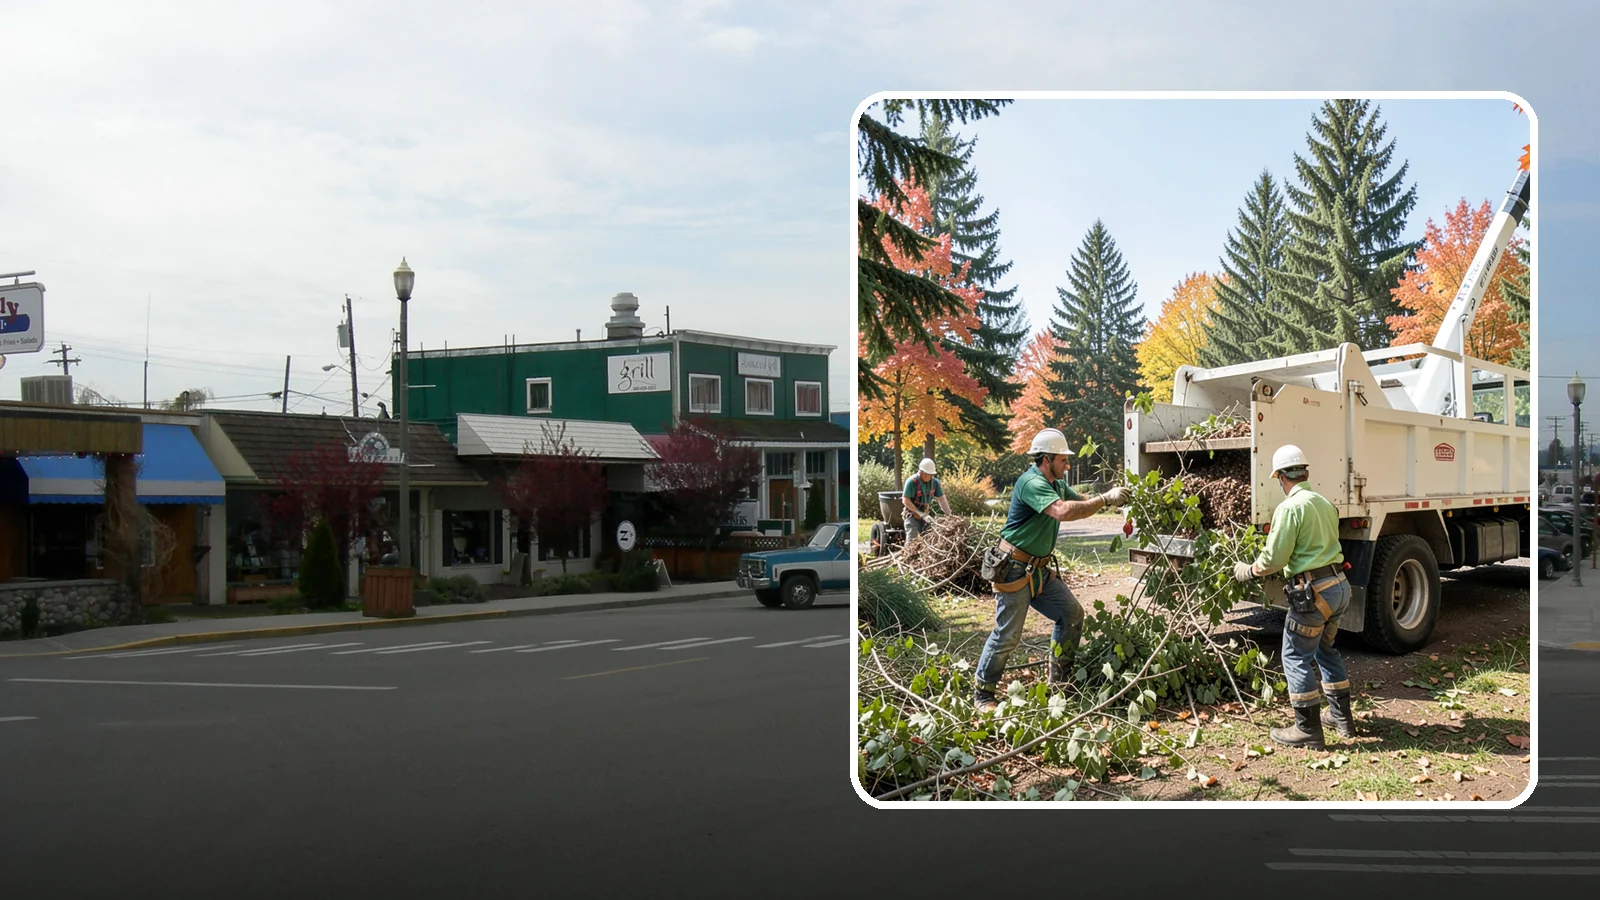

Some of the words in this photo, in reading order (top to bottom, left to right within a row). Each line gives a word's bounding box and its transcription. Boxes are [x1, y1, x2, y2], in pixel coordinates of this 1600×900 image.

[3, 338, 16, 346] Fries
[20, 337, 38, 345] Salads
[617, 356, 655, 391] grill
